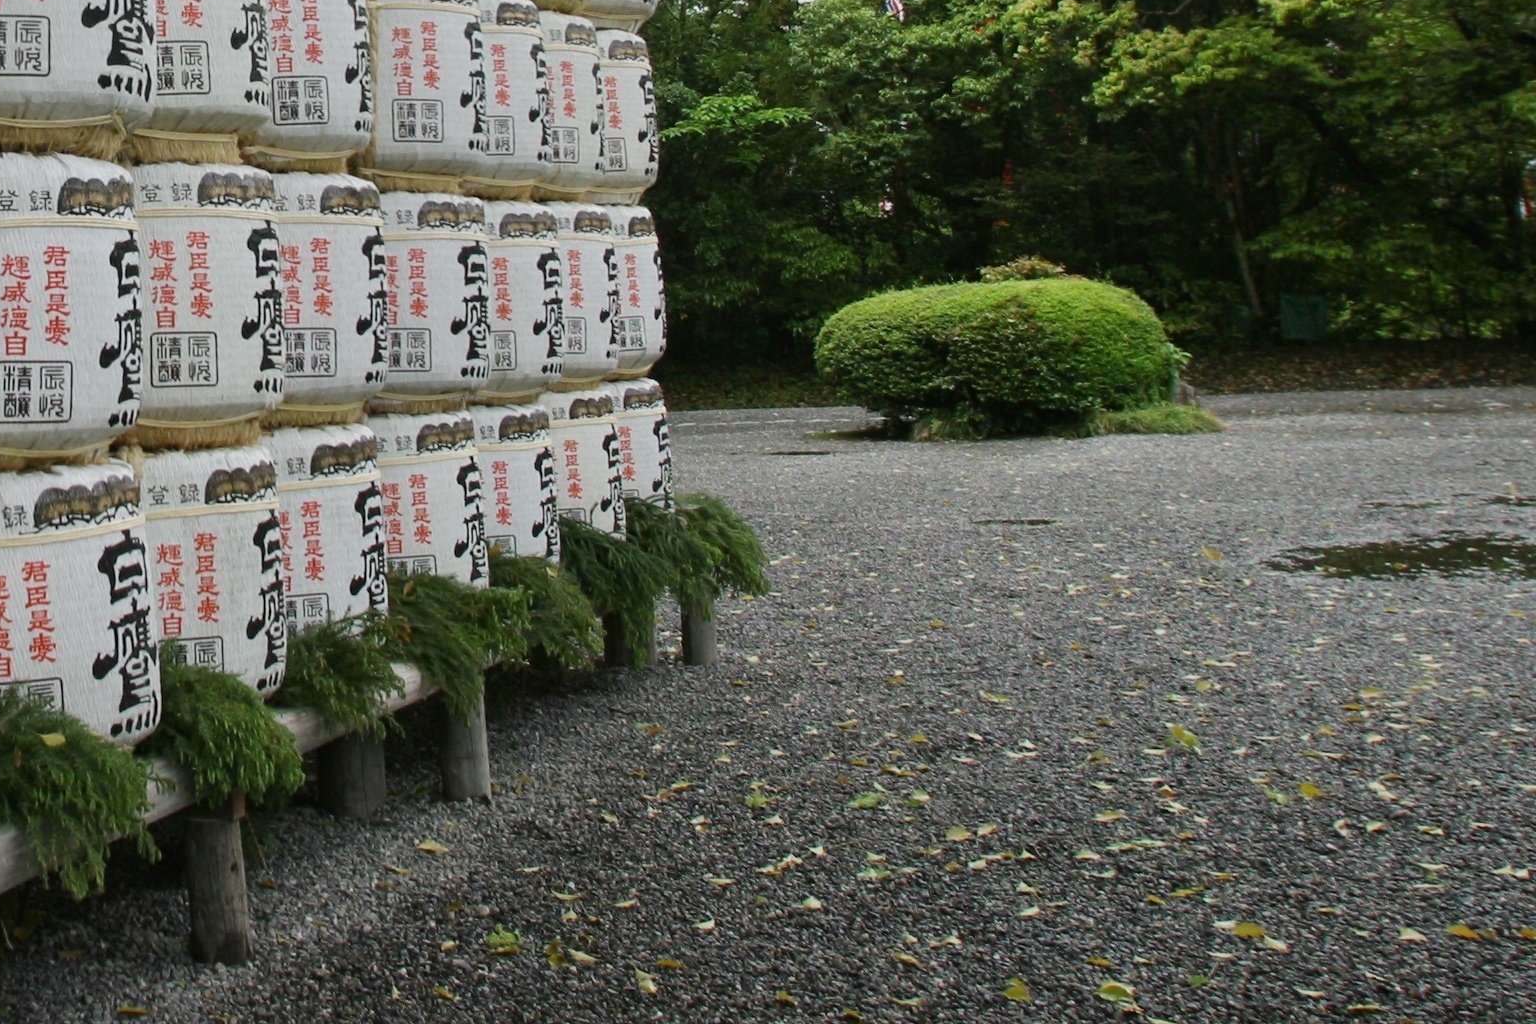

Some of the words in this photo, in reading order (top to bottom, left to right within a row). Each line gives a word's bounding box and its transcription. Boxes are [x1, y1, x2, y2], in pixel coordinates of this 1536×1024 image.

[140, 182, 193, 203] 登録
[147, 484, 200, 506] 登録
[92, 529, 158, 737] 白鷹
